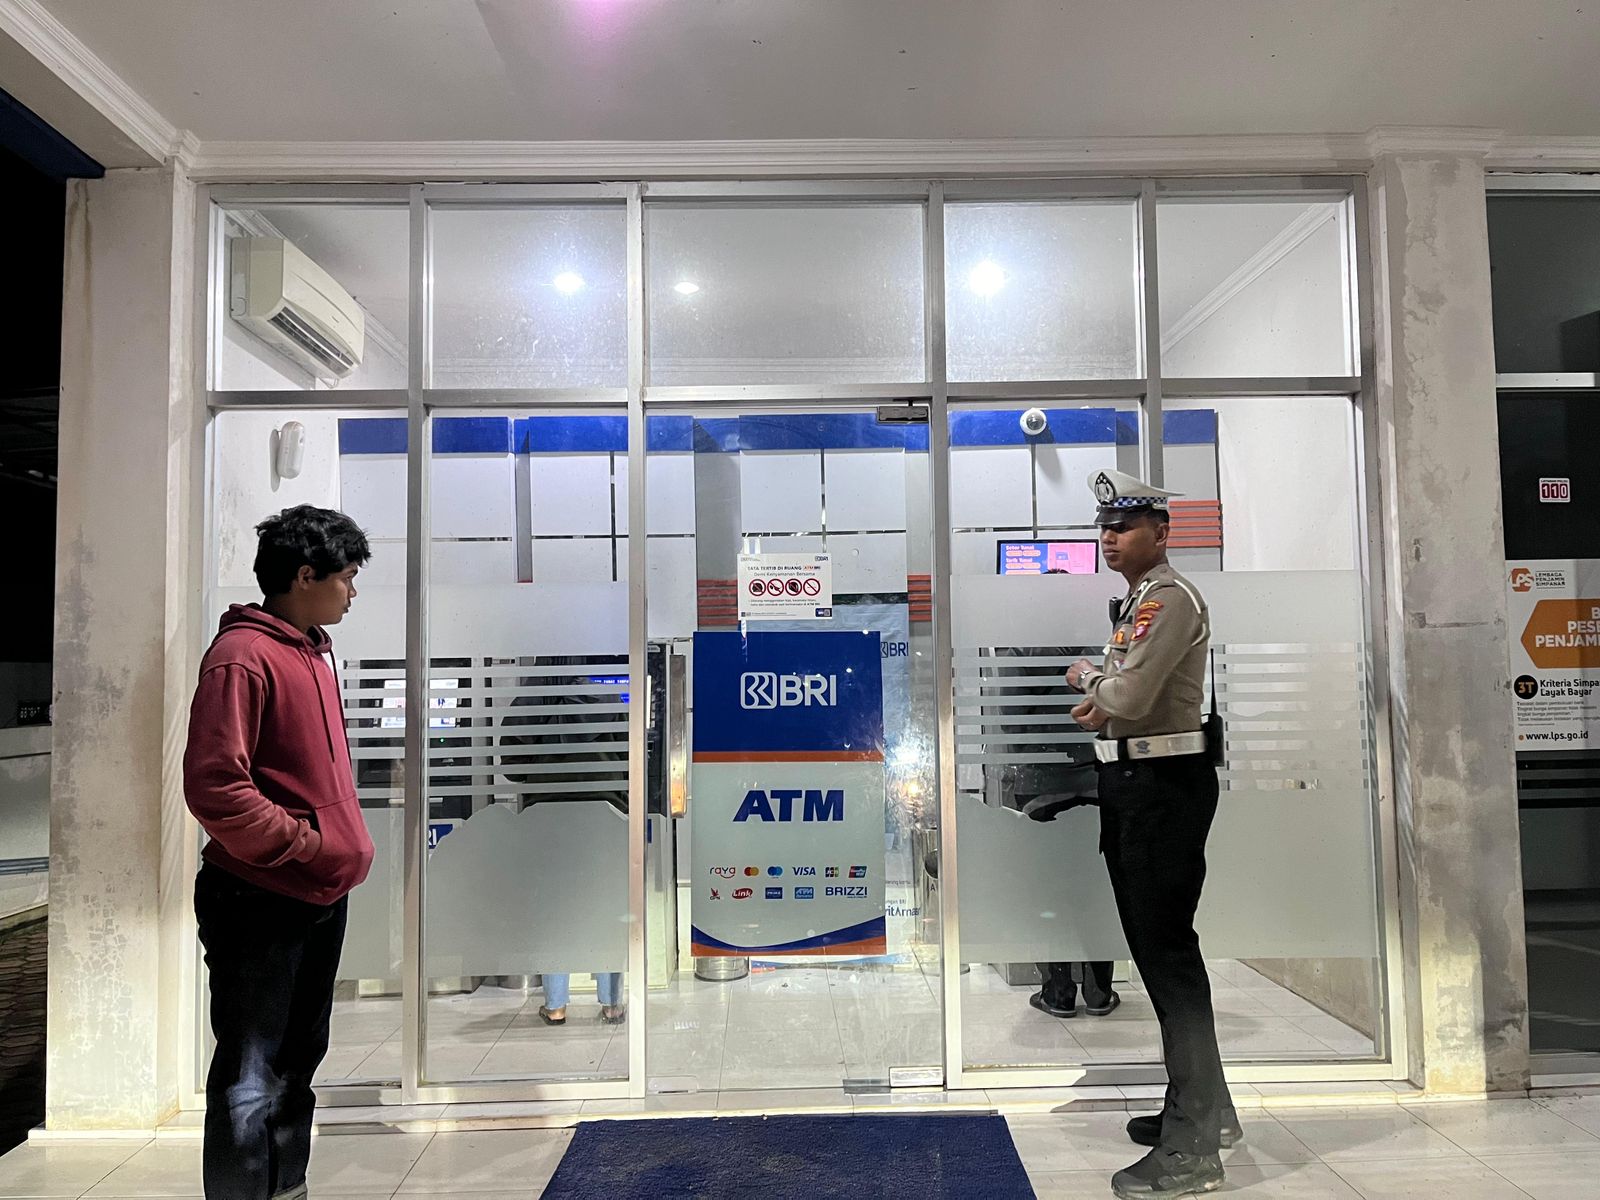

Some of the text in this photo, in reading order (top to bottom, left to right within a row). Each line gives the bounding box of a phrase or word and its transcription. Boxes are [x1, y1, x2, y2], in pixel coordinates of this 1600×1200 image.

[1542, 485, 1567, 497] 110
[889, 642, 909, 657] BRI
[1518, 682, 1535, 694] 3T
[1540, 679, 1572, 688] Kriteria
[779, 674, 837, 706] BRI
[1540, 688, 1593, 698] Layak Bayar
[1525, 731, 1589, 741] www.lps.go.id
[733, 789, 844, 822] ATM
[792, 867, 816, 876] VISA
[733, 889, 751, 897] Link
[825, 887, 867, 896] BRIZZI
